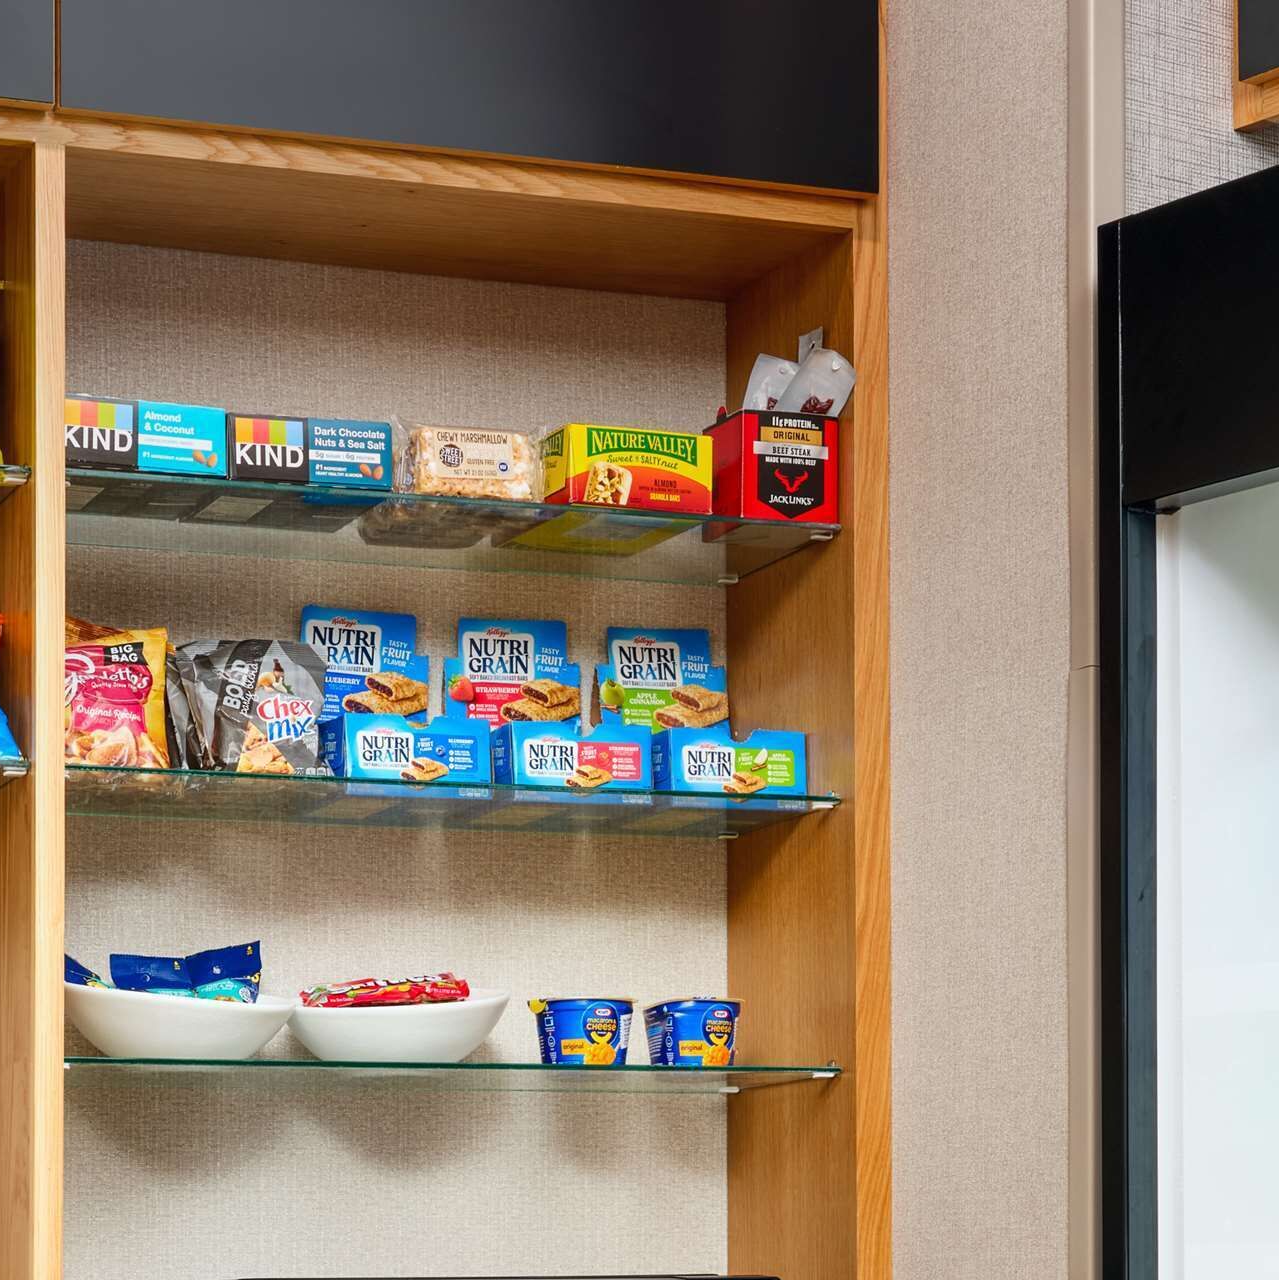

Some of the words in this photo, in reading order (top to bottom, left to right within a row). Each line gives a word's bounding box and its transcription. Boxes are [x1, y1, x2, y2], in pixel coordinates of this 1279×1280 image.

[144, 411, 181, 423] Almond
[784, 418, 812, 429] PROTEIN
[144, 423, 151, 431] &
[154, 422, 194, 435] Coconut
[315, 426, 336, 436] Dark
[338, 428, 385, 439] Chocolate
[65, 424, 133, 451] KIND
[437, 431, 458, 442] CHEWY
[460, 432, 508, 445] MARSHMALLOW
[773, 431, 810, 441] ORIGINAL
[315, 438, 336, 447] Nuts
[338, 440, 345, 448] &
[347, 440, 365, 449] Sea
[368, 440, 385, 450] Salt
[591, 430, 646, 454] NATURE
[647, 437, 697, 462] VALLEY
[236, 443, 304, 468] KIND
[772, 446, 789, 455] BEEF
[791, 447, 811, 456] STEAK
[606, 454, 633, 464] Sweet
[641, 455, 660, 467] SALTY
[660, 461, 679, 470] nut
[769, 495, 788, 504] JACK
[312, 626, 376, 647] NUTRI
[110, 644, 134, 654] BIG
[389, 640, 408, 648] TASTY
[469, 638, 528, 657] NUTRI
[111, 653, 138, 662] BAG
[327, 645, 376, 666] RAIN
[382, 647, 412, 660] FRUIT
[618, 646, 674, 664] NUTRI
[383, 658, 406, 667] FLAVOR
[469, 655, 528, 674] GRAIN
[535, 655, 564, 666] FRUIT
[620, 662, 677, 680] GRAIN
[681, 662, 709, 673] FRUIT
[325, 677, 360, 685] LUEBERRY
[76, 704, 112, 718] Original
[257, 695, 314, 720] Chex
[362, 736, 410, 750] NUTRI
[362, 748, 410, 763] GRAIN
[529, 744, 574, 758] NUTRI
[688, 751, 731, 764] NUTRI
[529, 757, 574, 771] GRAIN
[688, 764, 732, 777] GRAIN
[563, 1043, 584, 1051] original
